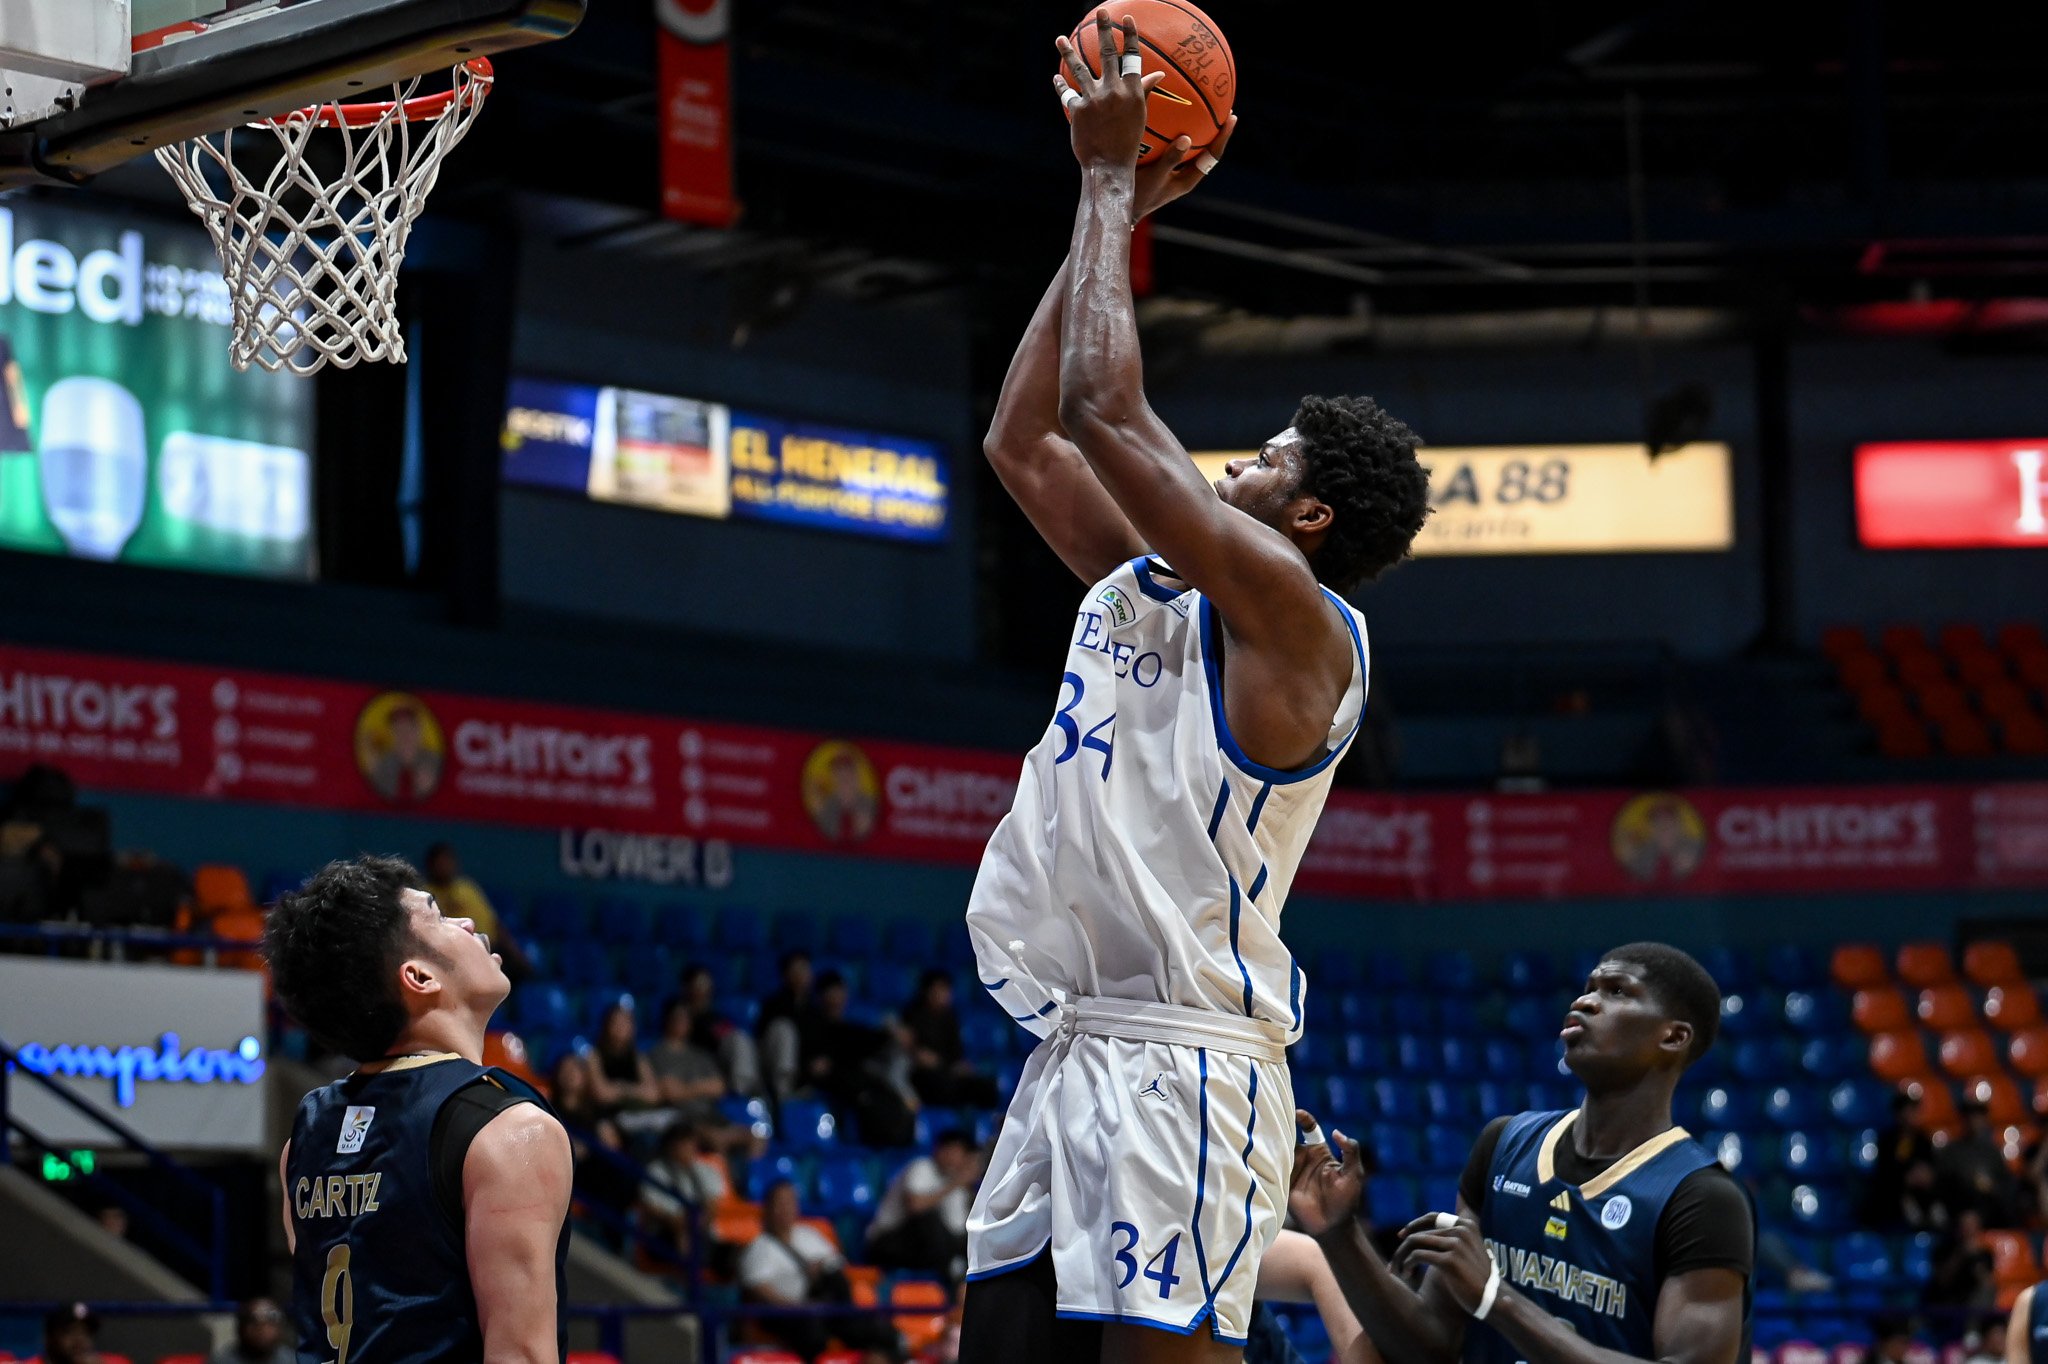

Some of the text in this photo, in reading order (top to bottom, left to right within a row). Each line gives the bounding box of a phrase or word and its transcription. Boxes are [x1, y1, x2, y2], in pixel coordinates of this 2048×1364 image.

[1496, 460, 1571, 504] 88
[1112, 598, 1129, 623] Smart
[453, 719, 652, 785] CHITOK'S
[1054, 671, 1116, 783] 34
[1110, 1220, 1181, 1300] 34
[1509, 1246, 1627, 1319] NAZARETH
